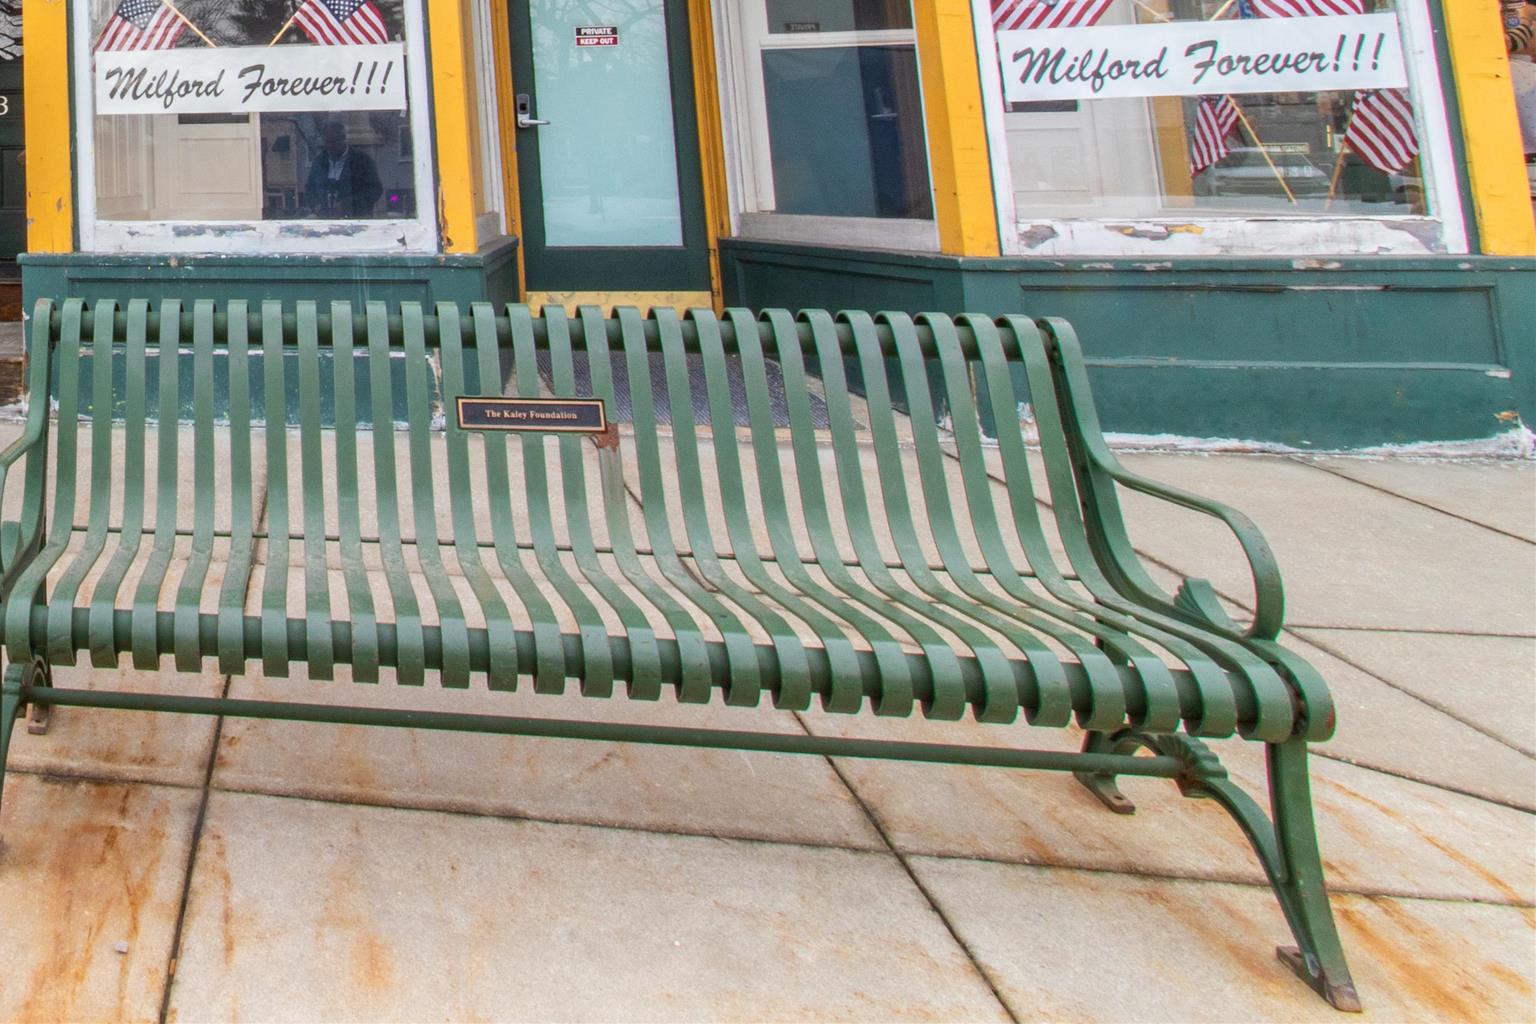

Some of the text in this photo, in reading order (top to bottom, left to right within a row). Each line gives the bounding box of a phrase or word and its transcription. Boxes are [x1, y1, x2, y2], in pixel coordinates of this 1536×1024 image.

[580, 27, 613, 36] PRIVATE
[579, 37, 615, 46] KEEP OUT
[1012, 31, 1386, 94] Milford Forever!!!
[105, 60, 395, 110] Milford Forever!!!
[484, 409, 501, 418] The
[529, 410, 578, 420] Foundation
